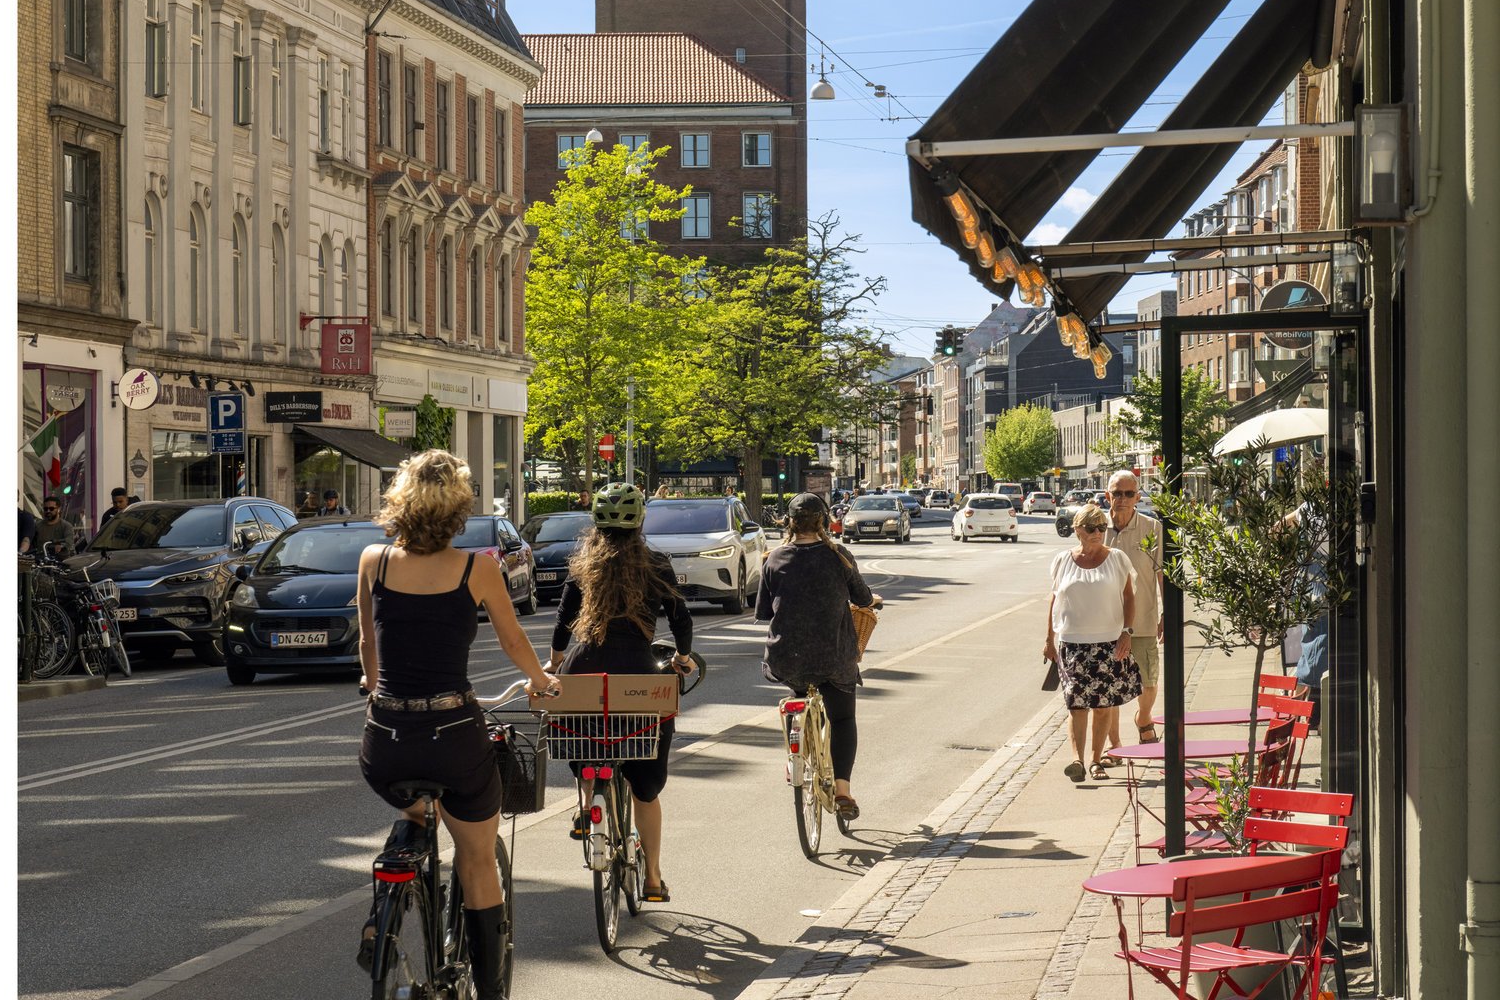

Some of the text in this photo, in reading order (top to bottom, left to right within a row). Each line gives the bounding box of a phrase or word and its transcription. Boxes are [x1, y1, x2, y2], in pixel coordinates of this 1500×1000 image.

[331, 357, 362, 371] RvH
[130, 381, 146, 391] OAK
[126, 387, 151, 398] BERRY
[218, 399, 237, 427] P
[387, 418, 411, 426] WEIHE
[119, 609, 136, 619] 253
[278, 633, 326, 644] DN 42 647
